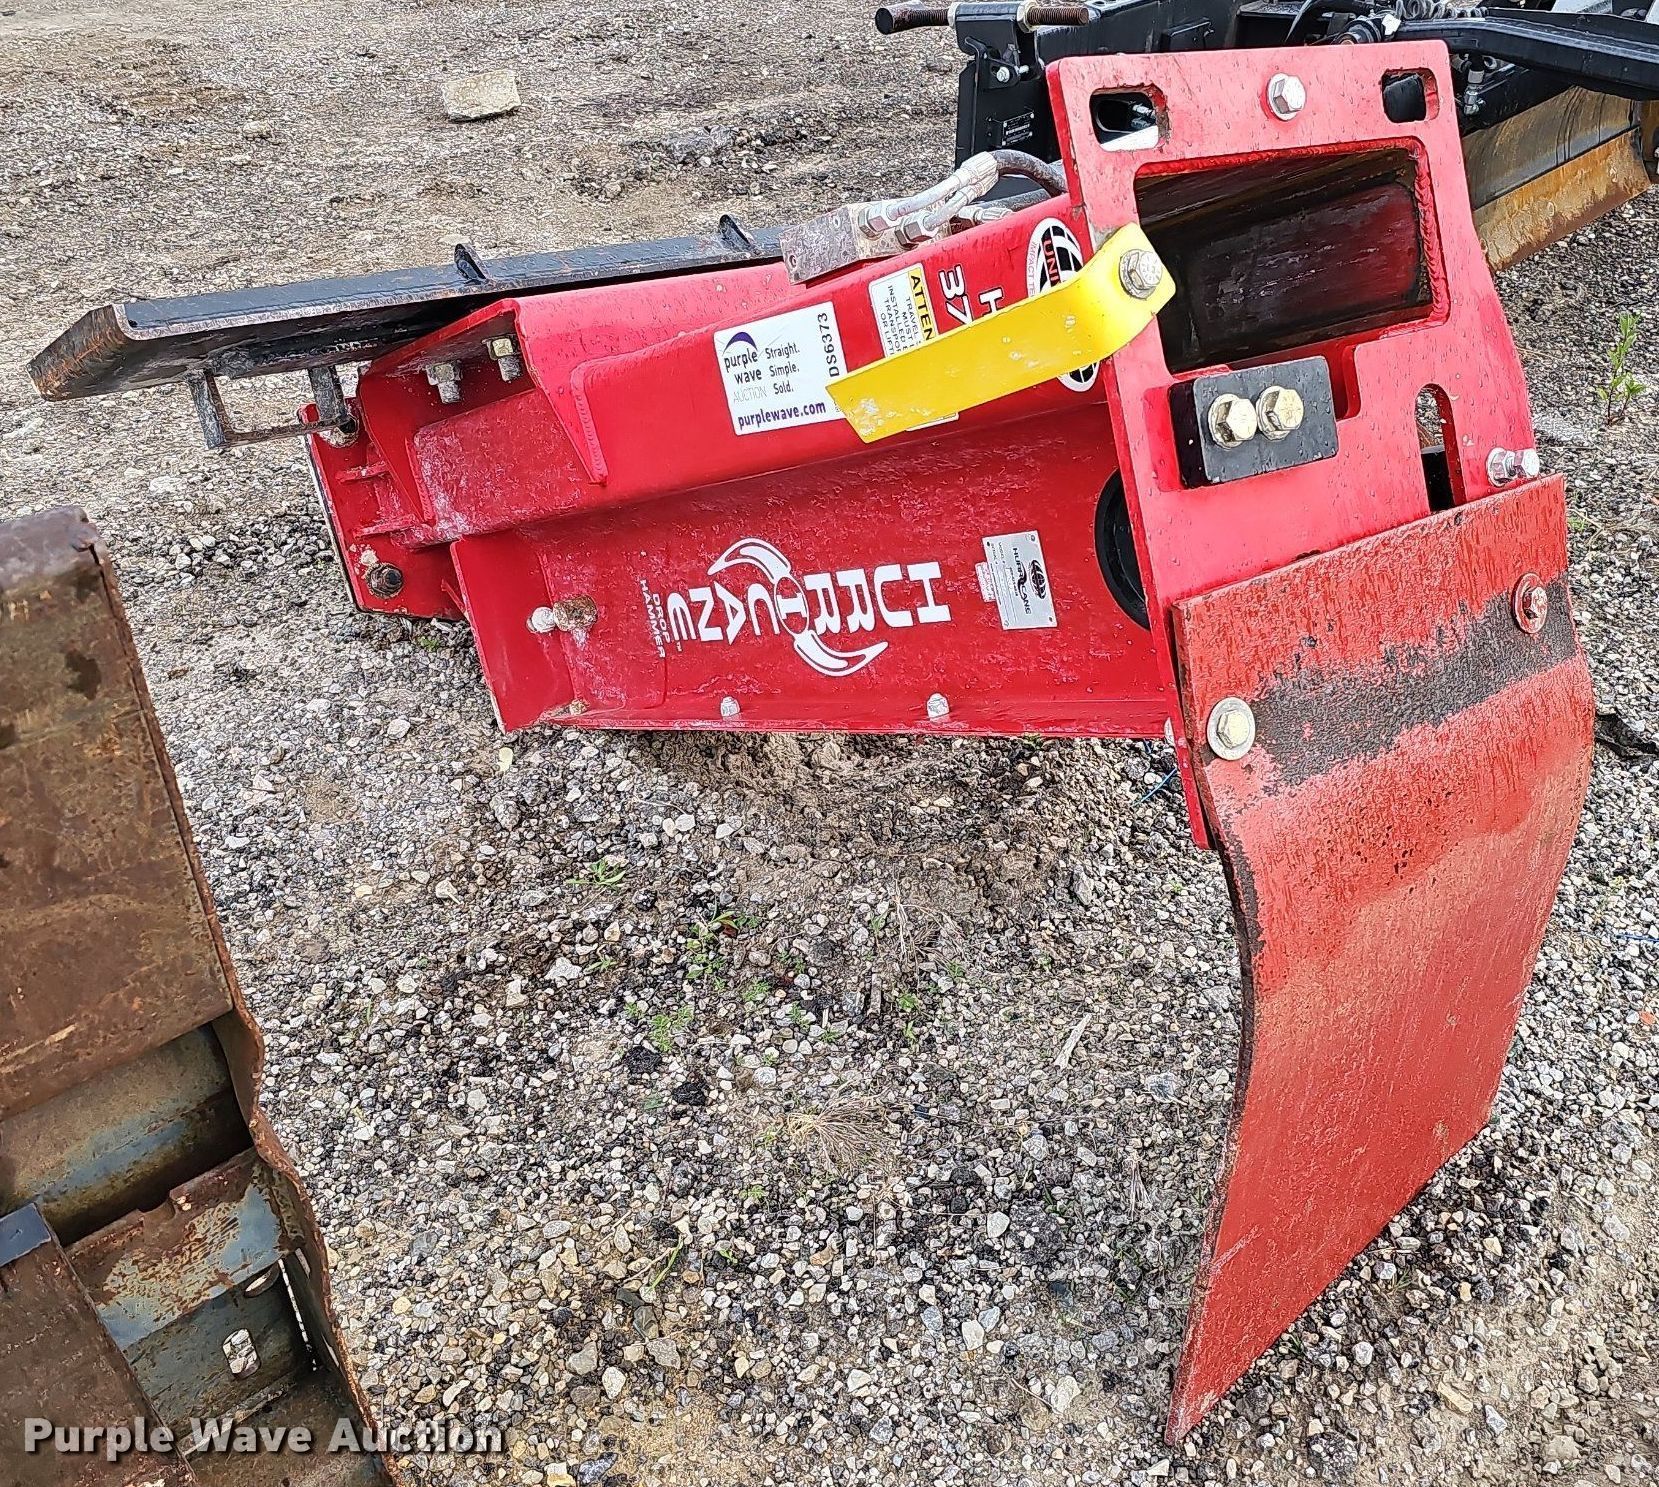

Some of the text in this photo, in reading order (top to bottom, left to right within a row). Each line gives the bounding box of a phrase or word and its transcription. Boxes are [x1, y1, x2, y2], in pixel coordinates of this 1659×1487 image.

[1028, 241, 1038, 279] IMPACT
[1043, 239, 1060, 282] UNI
[880, 313, 888, 327] OR
[884, 298, 902, 352] TRANSPO
[888, 285, 906, 343] INSTALLED
[902, 312, 913, 340] MUST
[905, 296, 919, 338] TRAVEL
[911, 275, 934, 341] ATTEN
[723, 348, 758, 372] purple
[765, 342, 800, 359] Straight.
[817, 312, 840, 377] DS6373
[734, 368, 762, 385] wave
[768, 361, 800, 377] Simple.
[773, 380, 794, 395] Sold.
[733, 385, 767, 403] AUCTION
[738, 401, 827, 430] purplewave.com
[640, 579, 666, 658] HAMMER
[653, 593, 671, 643] DROP
[667, 561, 951, 645] HURRICANE
